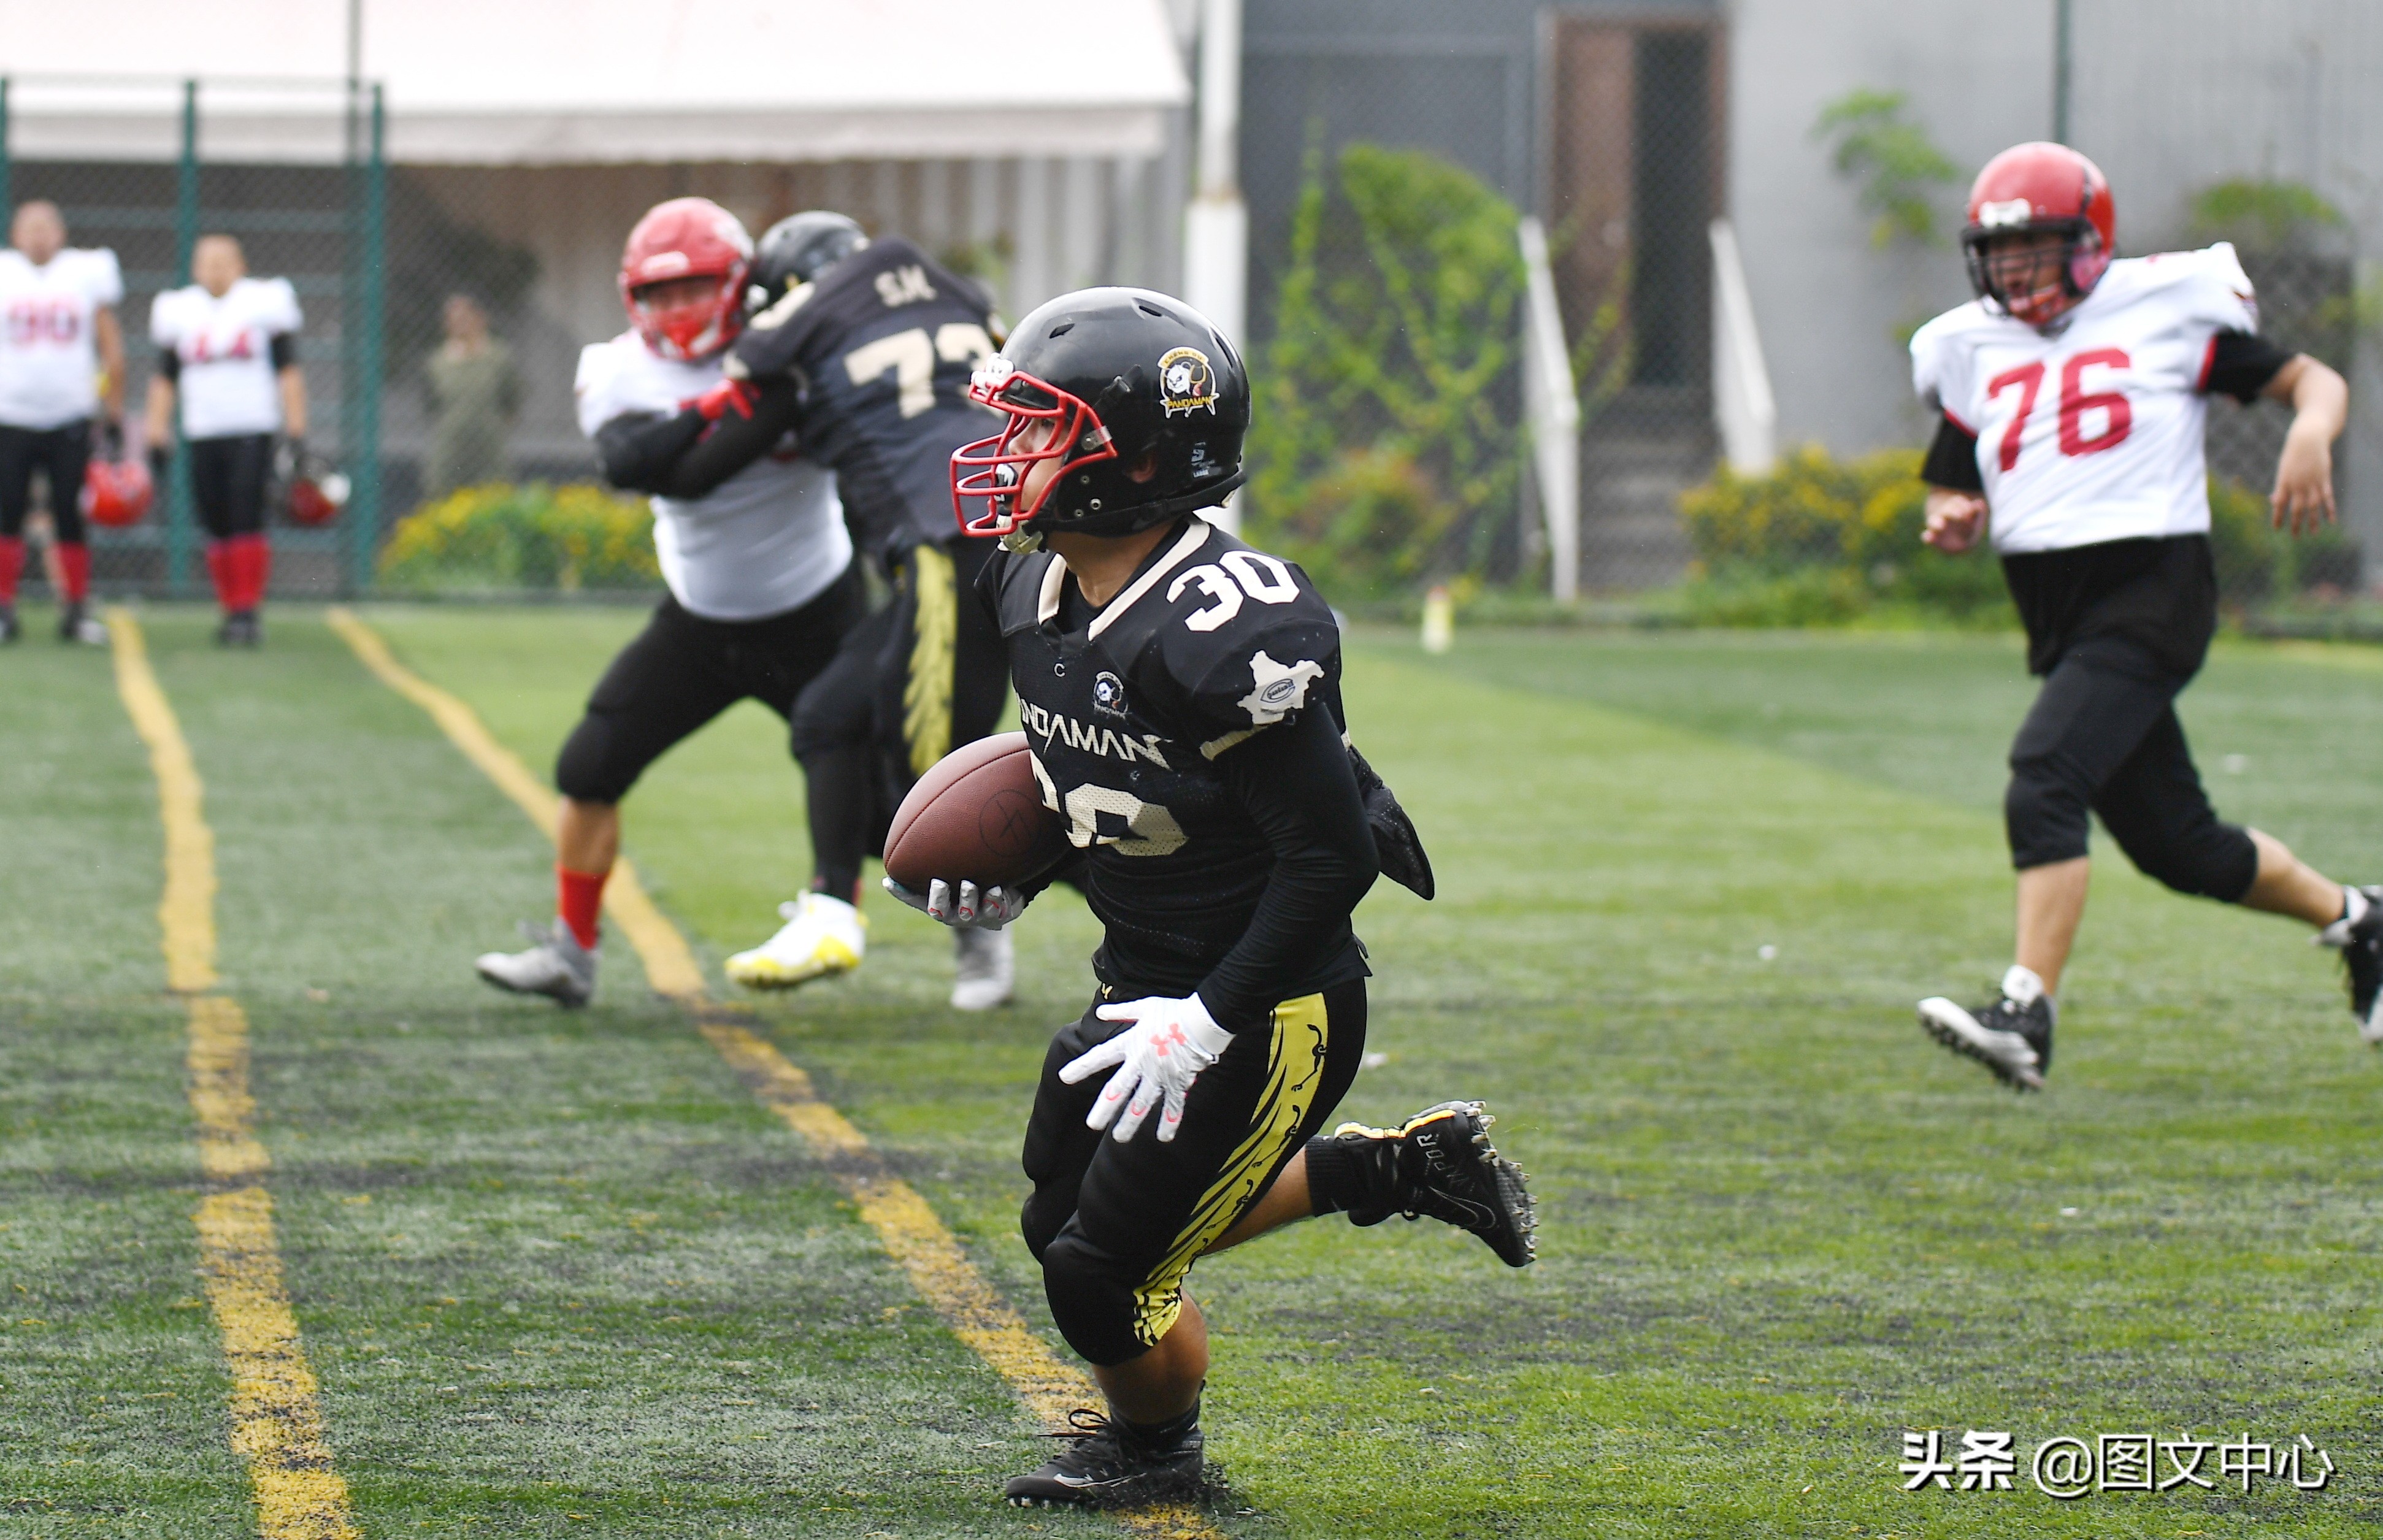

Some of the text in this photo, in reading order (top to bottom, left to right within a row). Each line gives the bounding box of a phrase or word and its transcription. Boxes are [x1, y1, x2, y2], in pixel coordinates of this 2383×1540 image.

[1167, 396, 1213, 409] PANDAMAN
[1987, 346, 2132, 472] 76
[1165, 550, 1301, 632] 30
[1054, 663, 1065, 677] C
